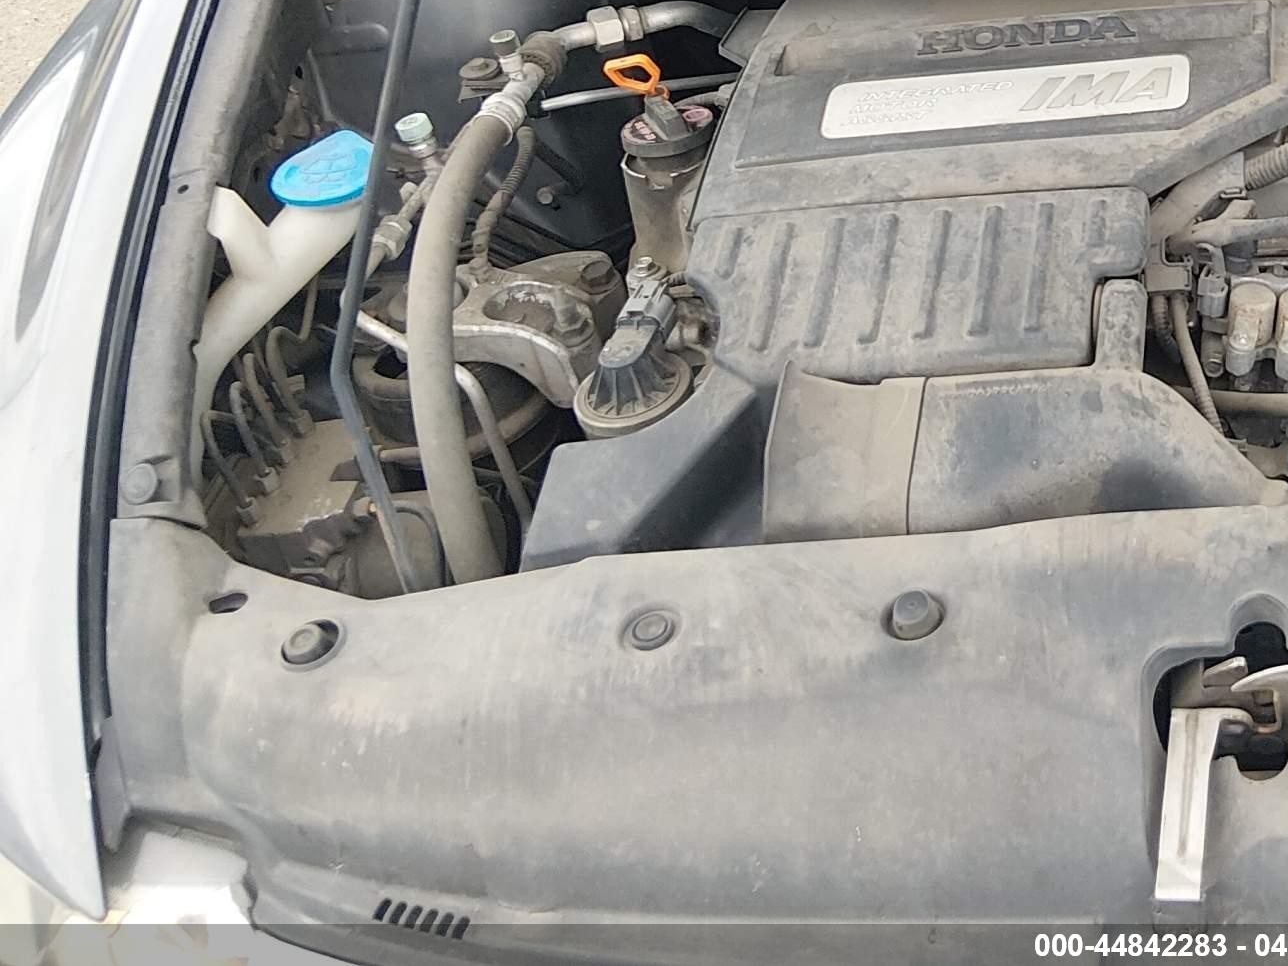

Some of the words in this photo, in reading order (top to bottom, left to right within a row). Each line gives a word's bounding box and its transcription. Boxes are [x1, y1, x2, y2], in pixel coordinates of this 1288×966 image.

[916, 15, 1137, 56] HONDA
[858, 80, 1015, 103] INTEGRATED
[1018, 66, 1174, 113] IMA
